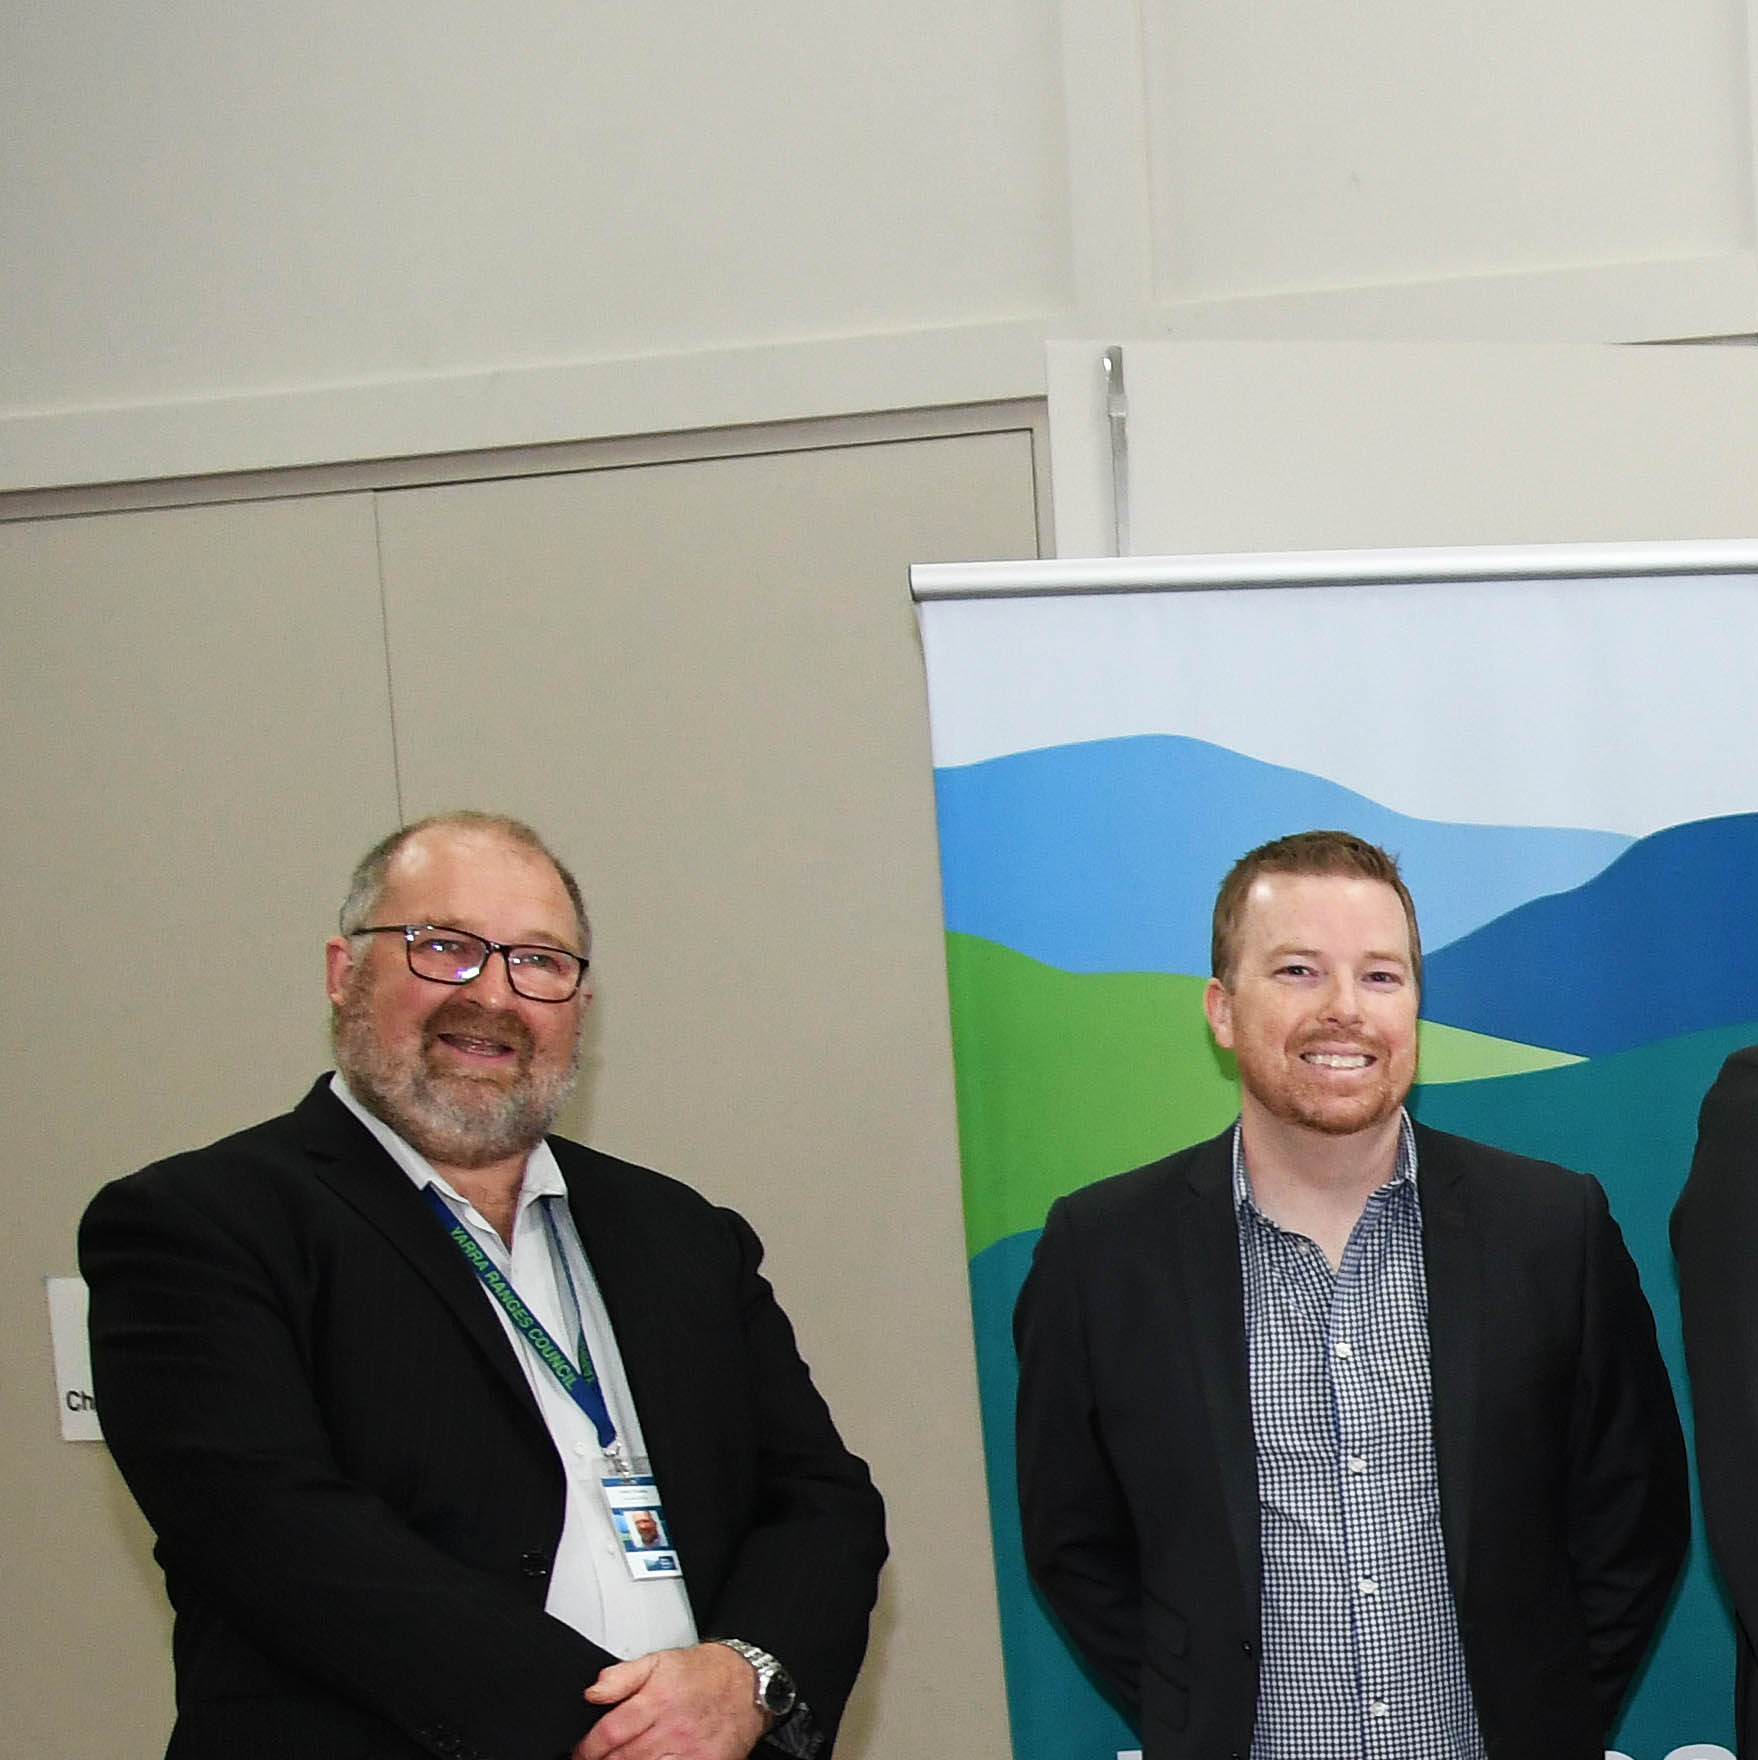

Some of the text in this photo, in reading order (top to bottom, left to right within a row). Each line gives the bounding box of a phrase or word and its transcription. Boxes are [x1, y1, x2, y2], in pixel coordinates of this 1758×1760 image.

[451, 1227, 577, 1391] YARRA RANGES COUNCIL
